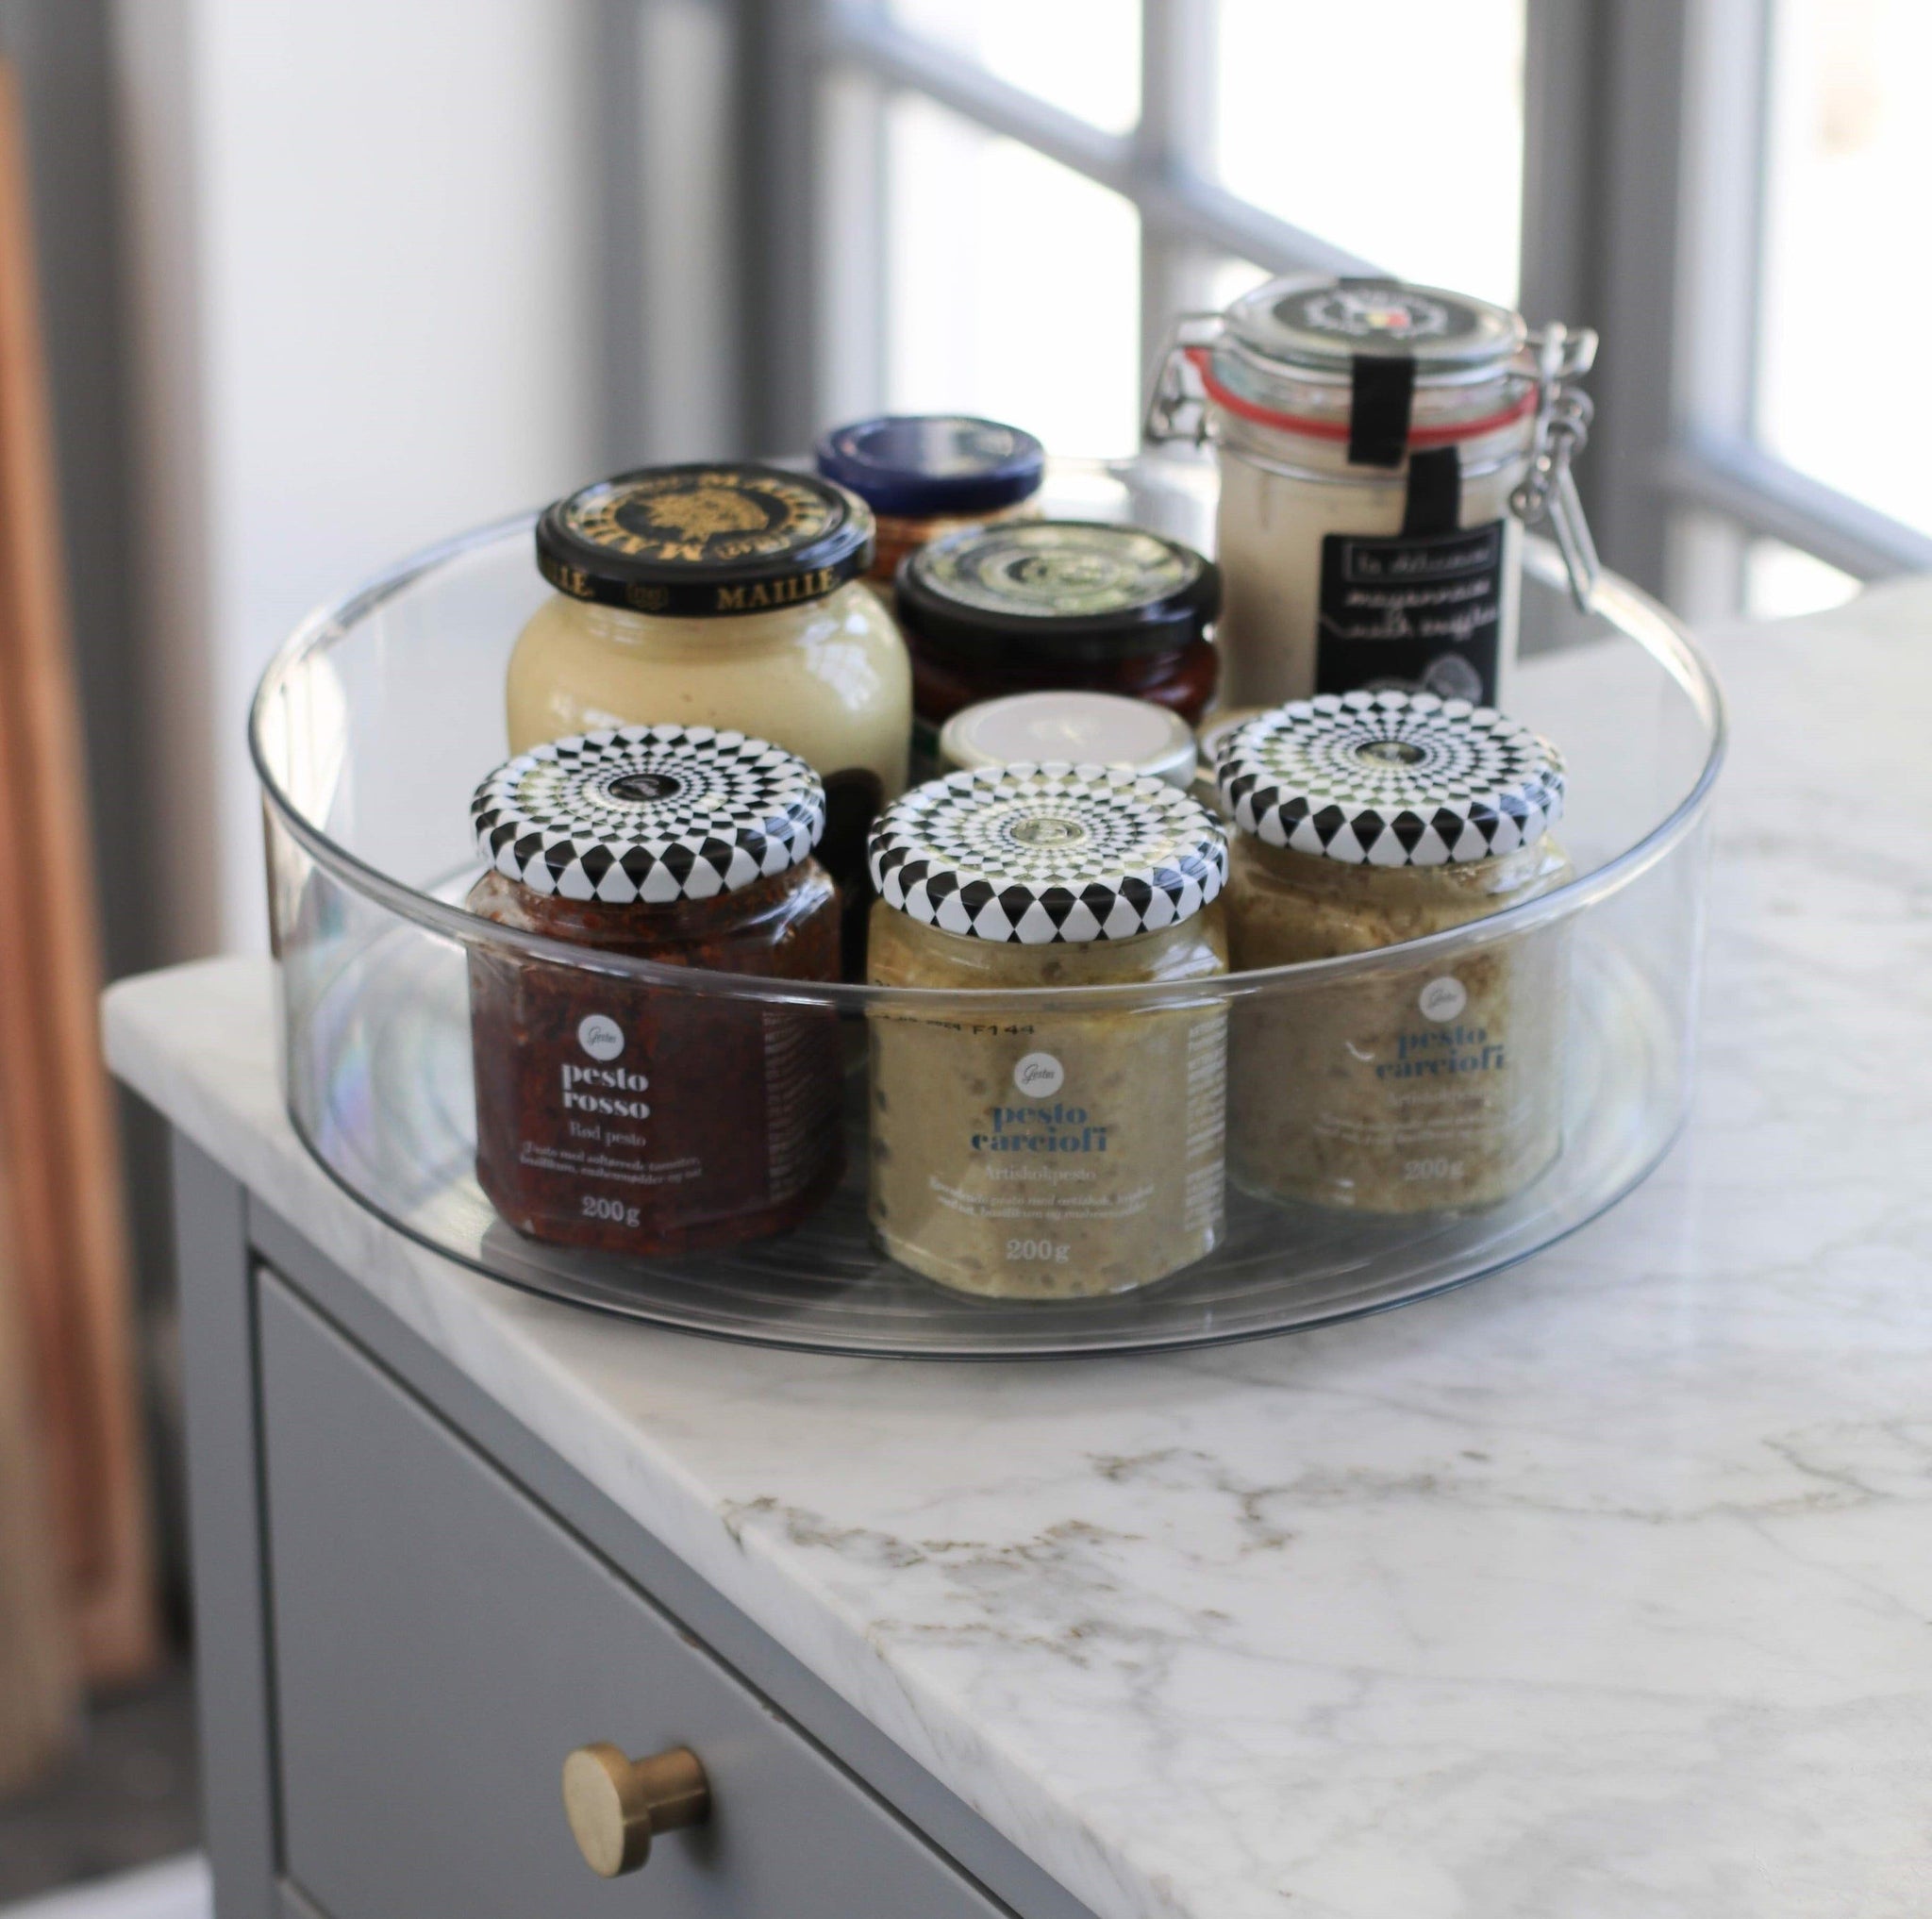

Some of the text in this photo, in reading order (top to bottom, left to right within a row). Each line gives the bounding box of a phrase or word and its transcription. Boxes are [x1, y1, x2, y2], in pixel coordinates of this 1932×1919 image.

[717, 568, 838, 611] MAILLE
[1398, 1025, 1488, 1060] pesto
[560, 1063, 649, 1093] pesto
[562, 1092, 651, 1120] rosso
[990, 1103, 1088, 1133] pesto
[605, 1130, 647, 1148] pesto
[971, 1126, 1108, 1152] carciofi
